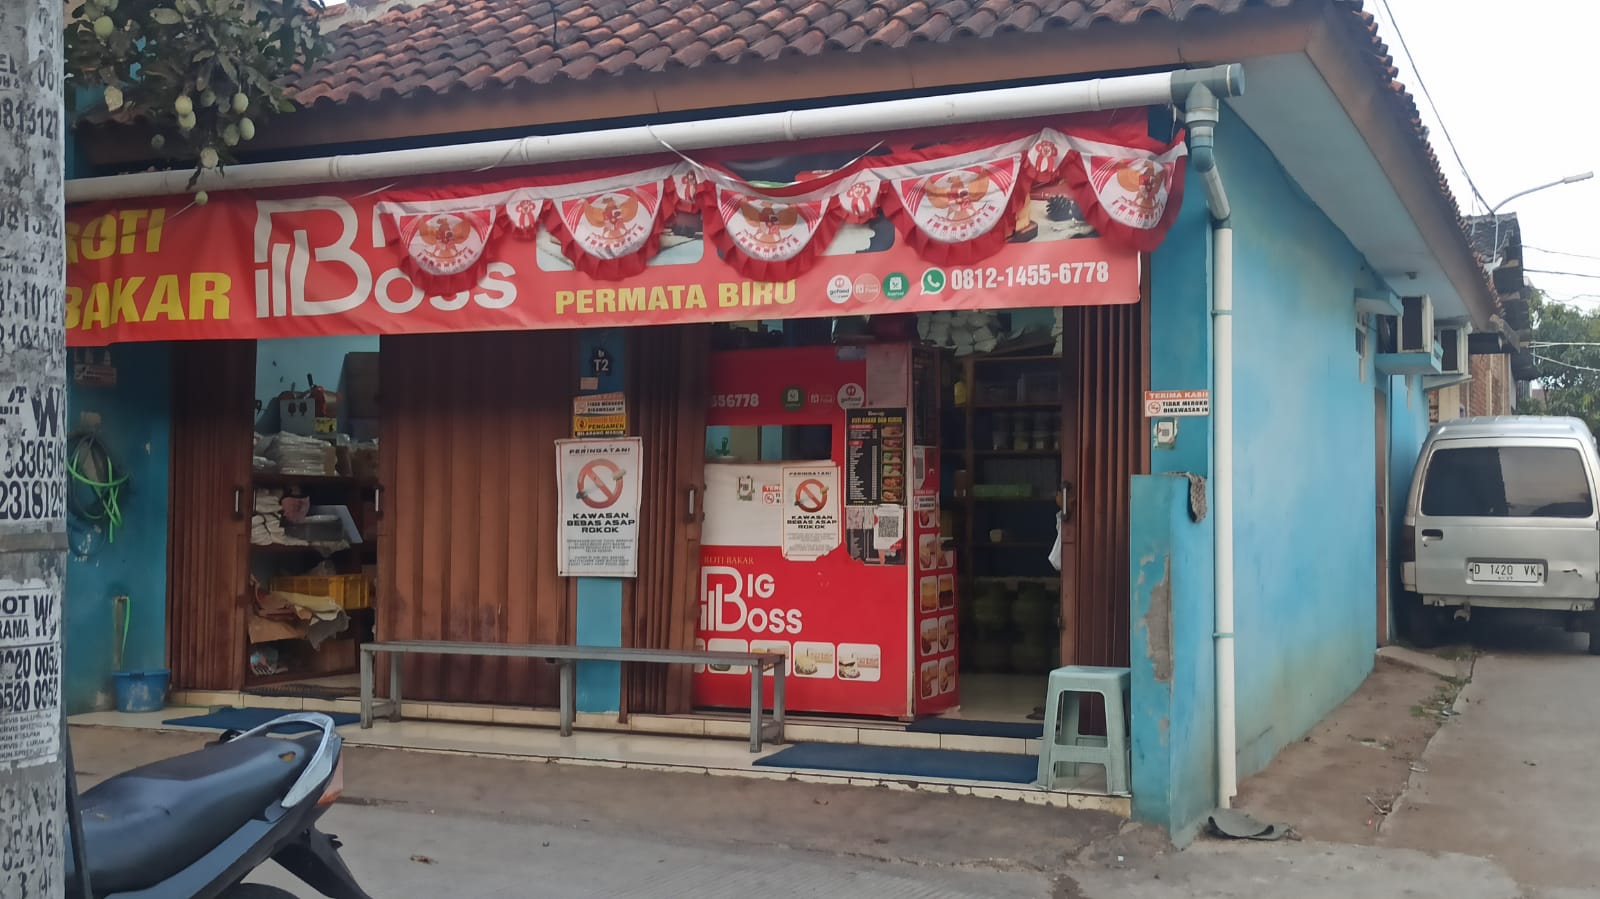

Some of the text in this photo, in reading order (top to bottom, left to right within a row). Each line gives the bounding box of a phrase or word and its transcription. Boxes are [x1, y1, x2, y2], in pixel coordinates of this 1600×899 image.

[66, 207, 165, 264] ROTI
[951, 261, 1109, 290] 0812-1455-6778
[66, 272, 232, 330] BAKAR
[555, 279, 797, 315] PERMATA BIRU
[573, 512, 629, 520] KAWASAN
[604, 519, 635, 527] ASAP
[1474, 564, 1536, 576] D 1420 VK
[0, 596, 30, 615] OT
